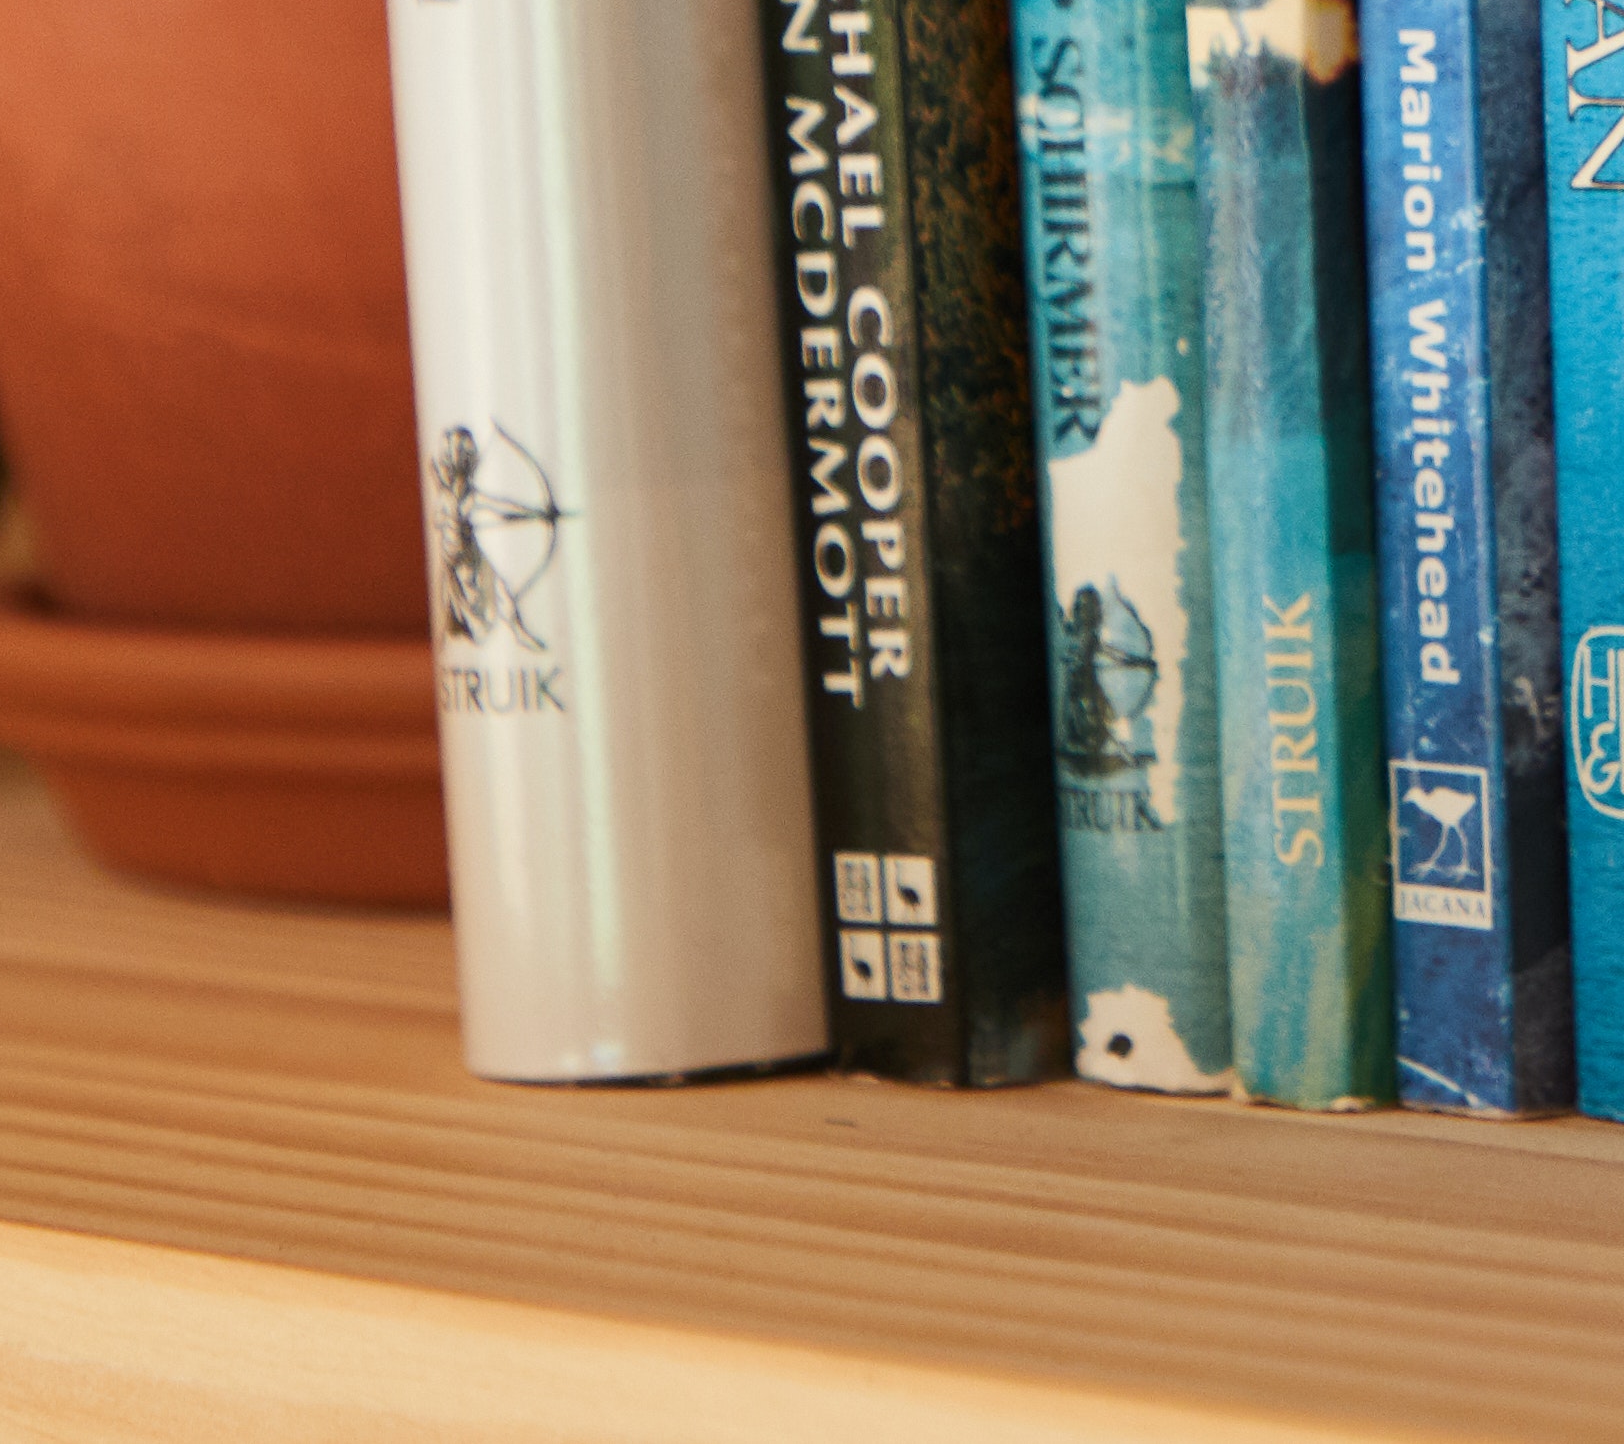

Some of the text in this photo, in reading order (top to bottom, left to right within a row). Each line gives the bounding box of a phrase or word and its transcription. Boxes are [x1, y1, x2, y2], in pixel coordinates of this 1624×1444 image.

[783, 96, 867, 706] MCDERMOTT
[1031, 35, 1103, 447] SCHIRMER
[1396, 25, 1464, 687] Marion Whitehead
[845, 284, 914, 681] COOPER
[438, 661, 565, 715] STRUIK
[1263, 592, 1327, 868] STRUIK
[1399, 890, 1488, 921] JACANA
